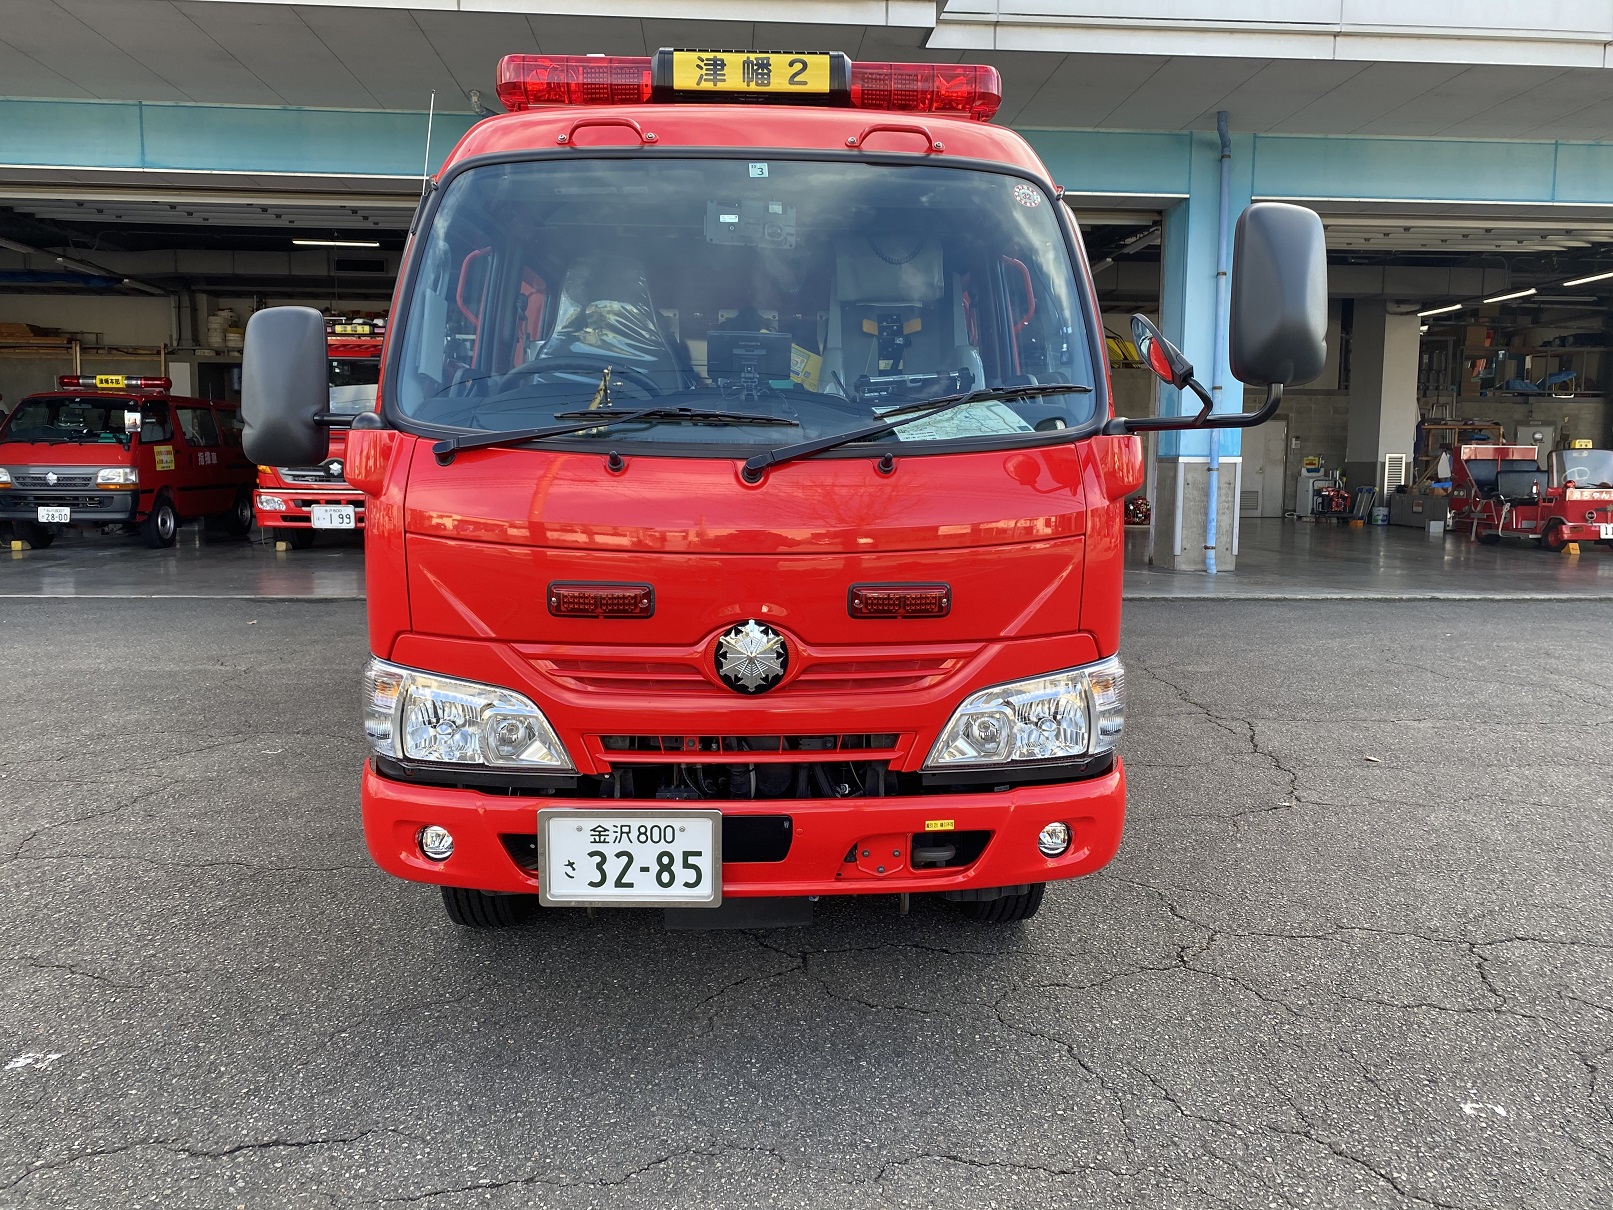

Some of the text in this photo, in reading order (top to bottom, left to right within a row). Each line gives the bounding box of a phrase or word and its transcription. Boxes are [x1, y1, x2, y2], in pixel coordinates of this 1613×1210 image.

[757, 167, 764, 176] 3
[590, 824, 676, 844] 金沢800
[564, 850, 704, 889] さ 32-85
